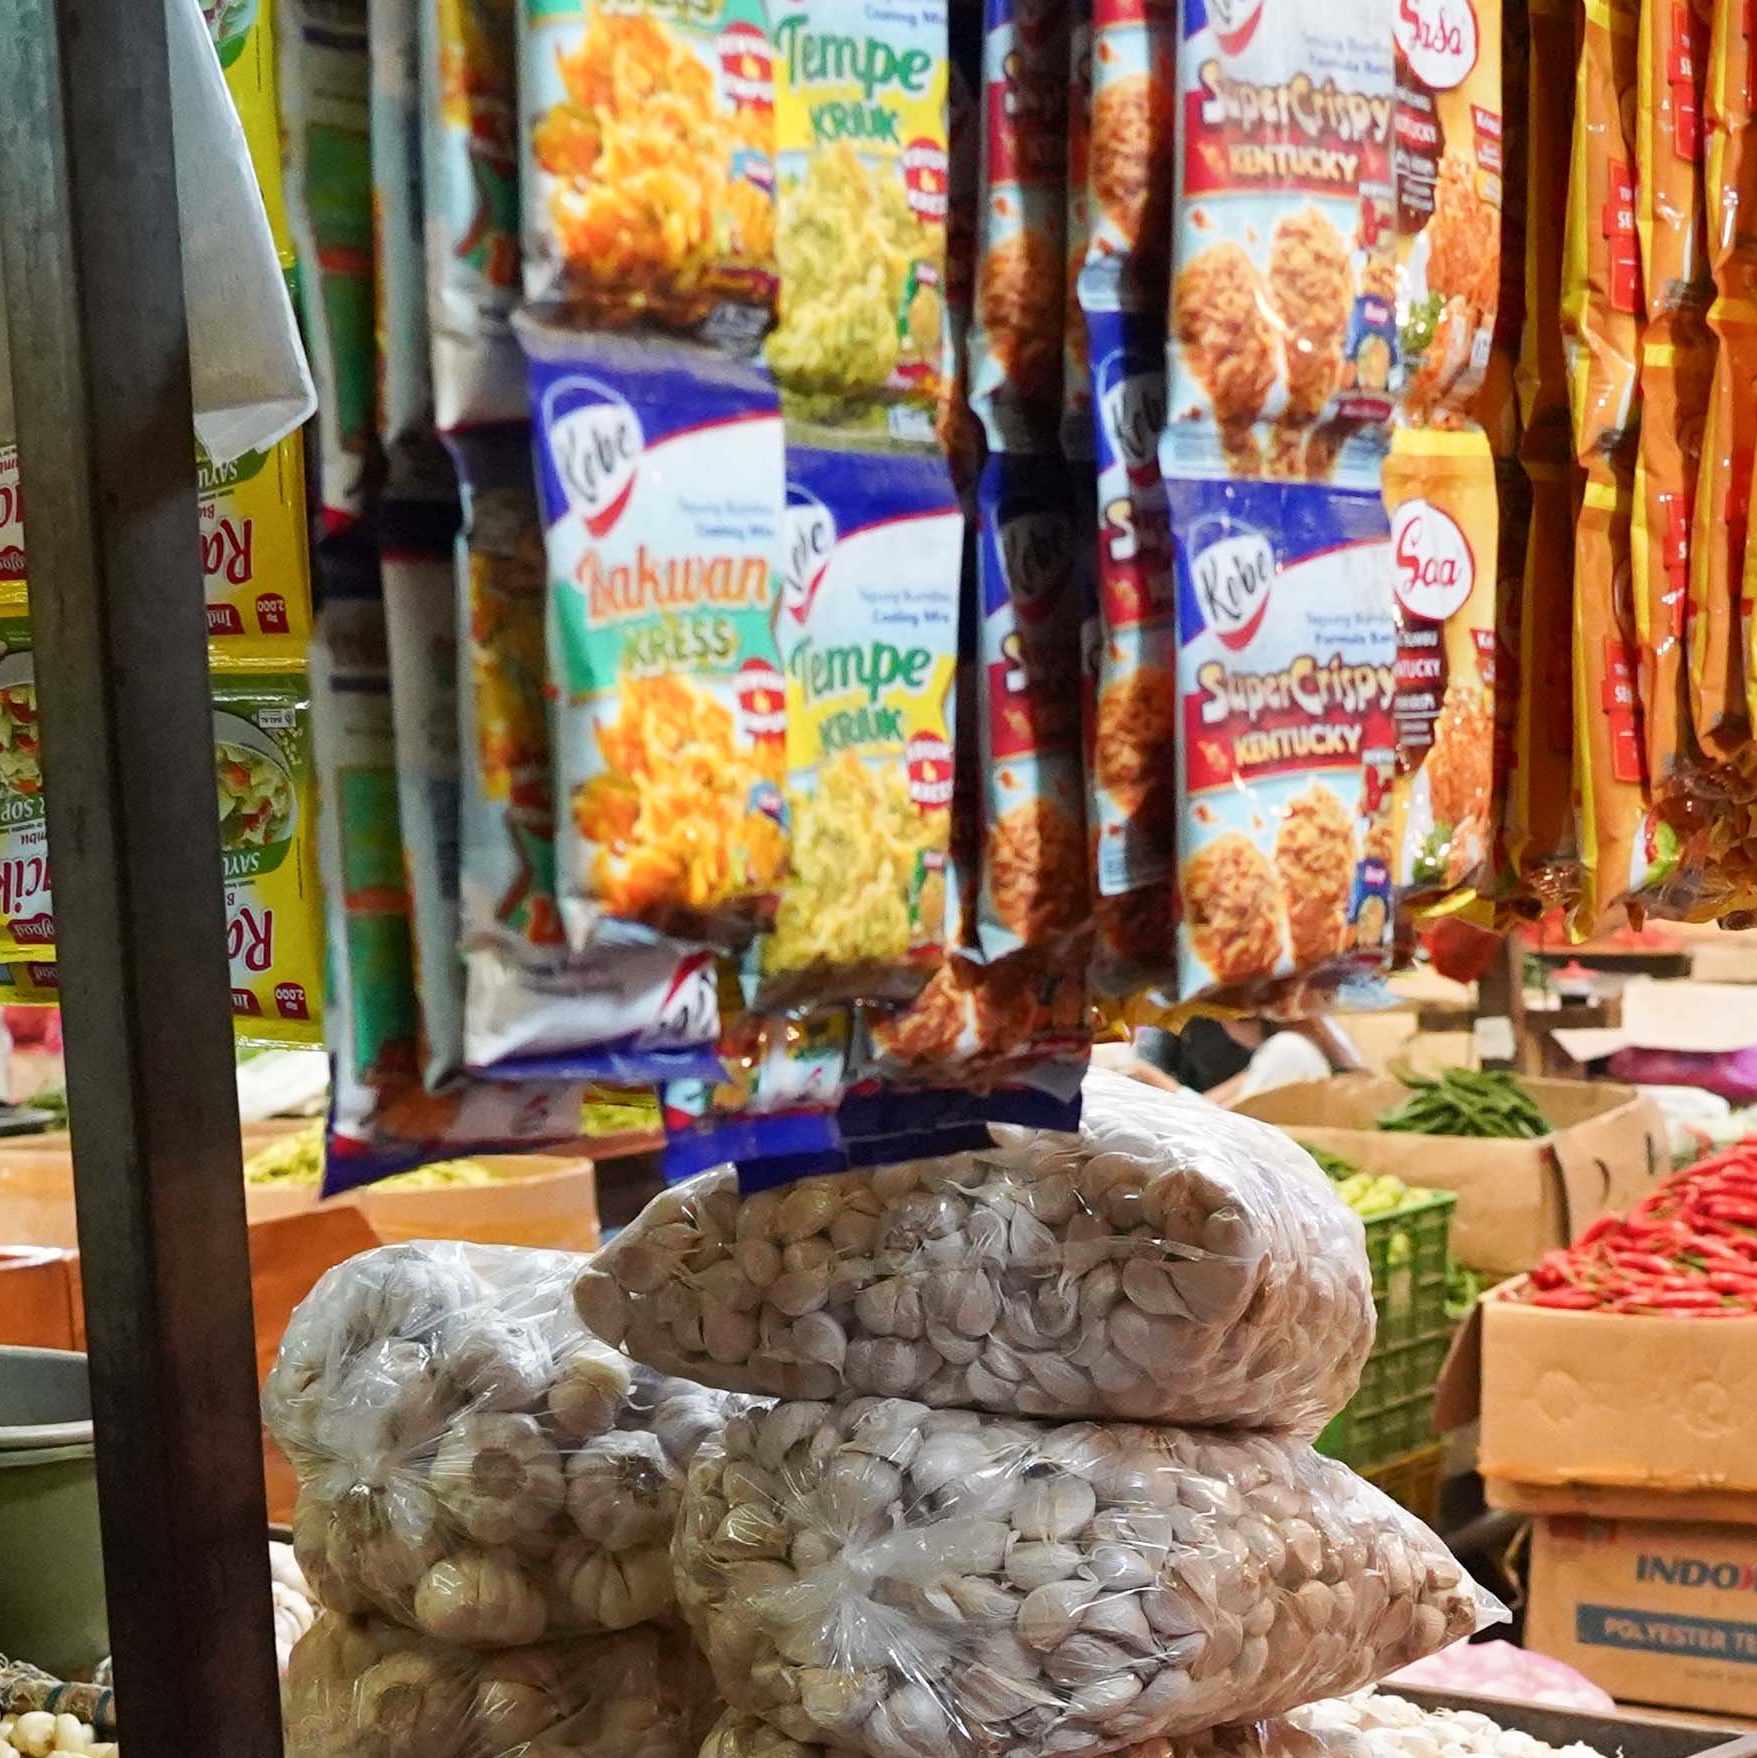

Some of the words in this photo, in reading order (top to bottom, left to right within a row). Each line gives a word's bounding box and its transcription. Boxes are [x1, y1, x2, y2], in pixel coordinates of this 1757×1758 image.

[774, 13, 932, 98] Tempe
[1228, 144, 1359, 183] KENTUCKY
[197, 459, 239, 491] SAYU
[1200, 551, 1268, 622] Kobe
[789, 637, 933, 702] Tempe
[1197, 652, 1393, 726] SuperCrispy
[1232, 723, 1363, 768] KENTUCKY
[0, 800, 33, 821] SOP
[1603, 1616, 1727, 1653] POLYESTER
